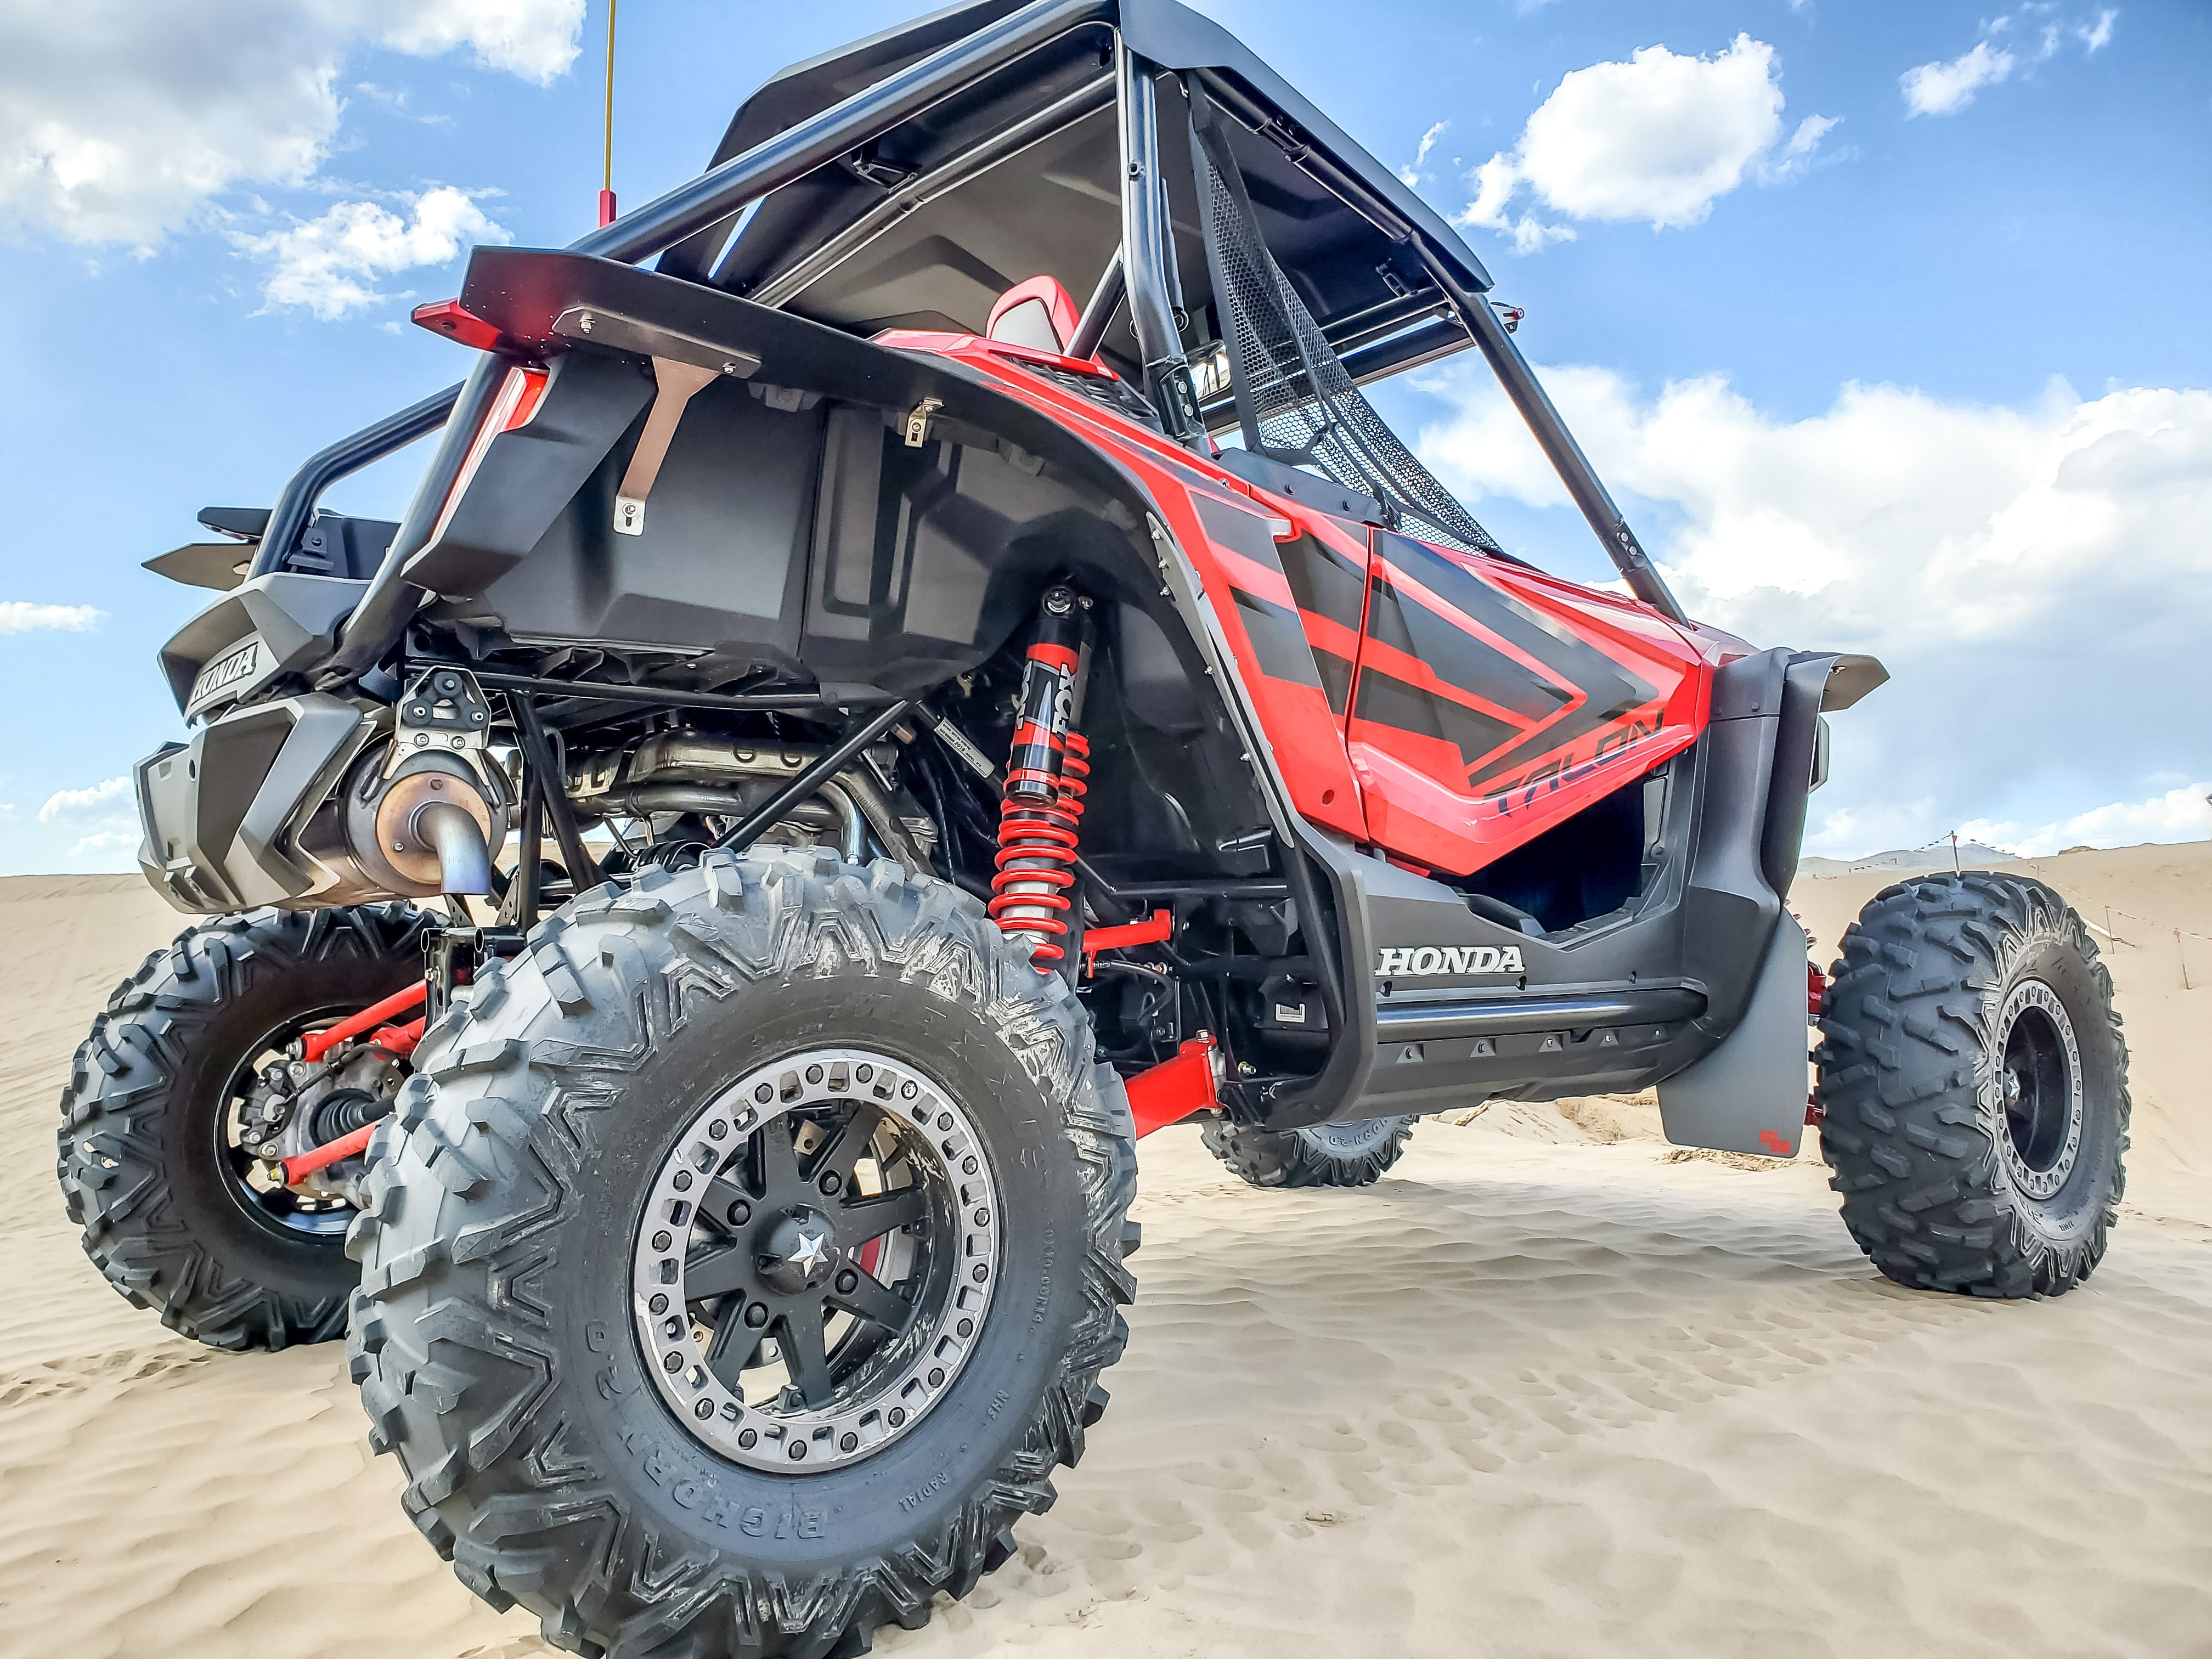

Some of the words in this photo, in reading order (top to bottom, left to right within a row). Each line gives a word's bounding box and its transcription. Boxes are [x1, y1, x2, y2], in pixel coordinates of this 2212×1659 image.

[192, 644, 259, 704] HONDA
[1052, 663, 1076, 735] FOX
[954, 741, 966, 752] 2019
[1483, 708, 1665, 817] TALON
[1374, 946, 1526, 976] HONDA
[988, 1390, 1011, 1420] NHS
[617, 1427, 828, 1539] BIGHORN
[898, 1472, 948, 1513] RADIAL
